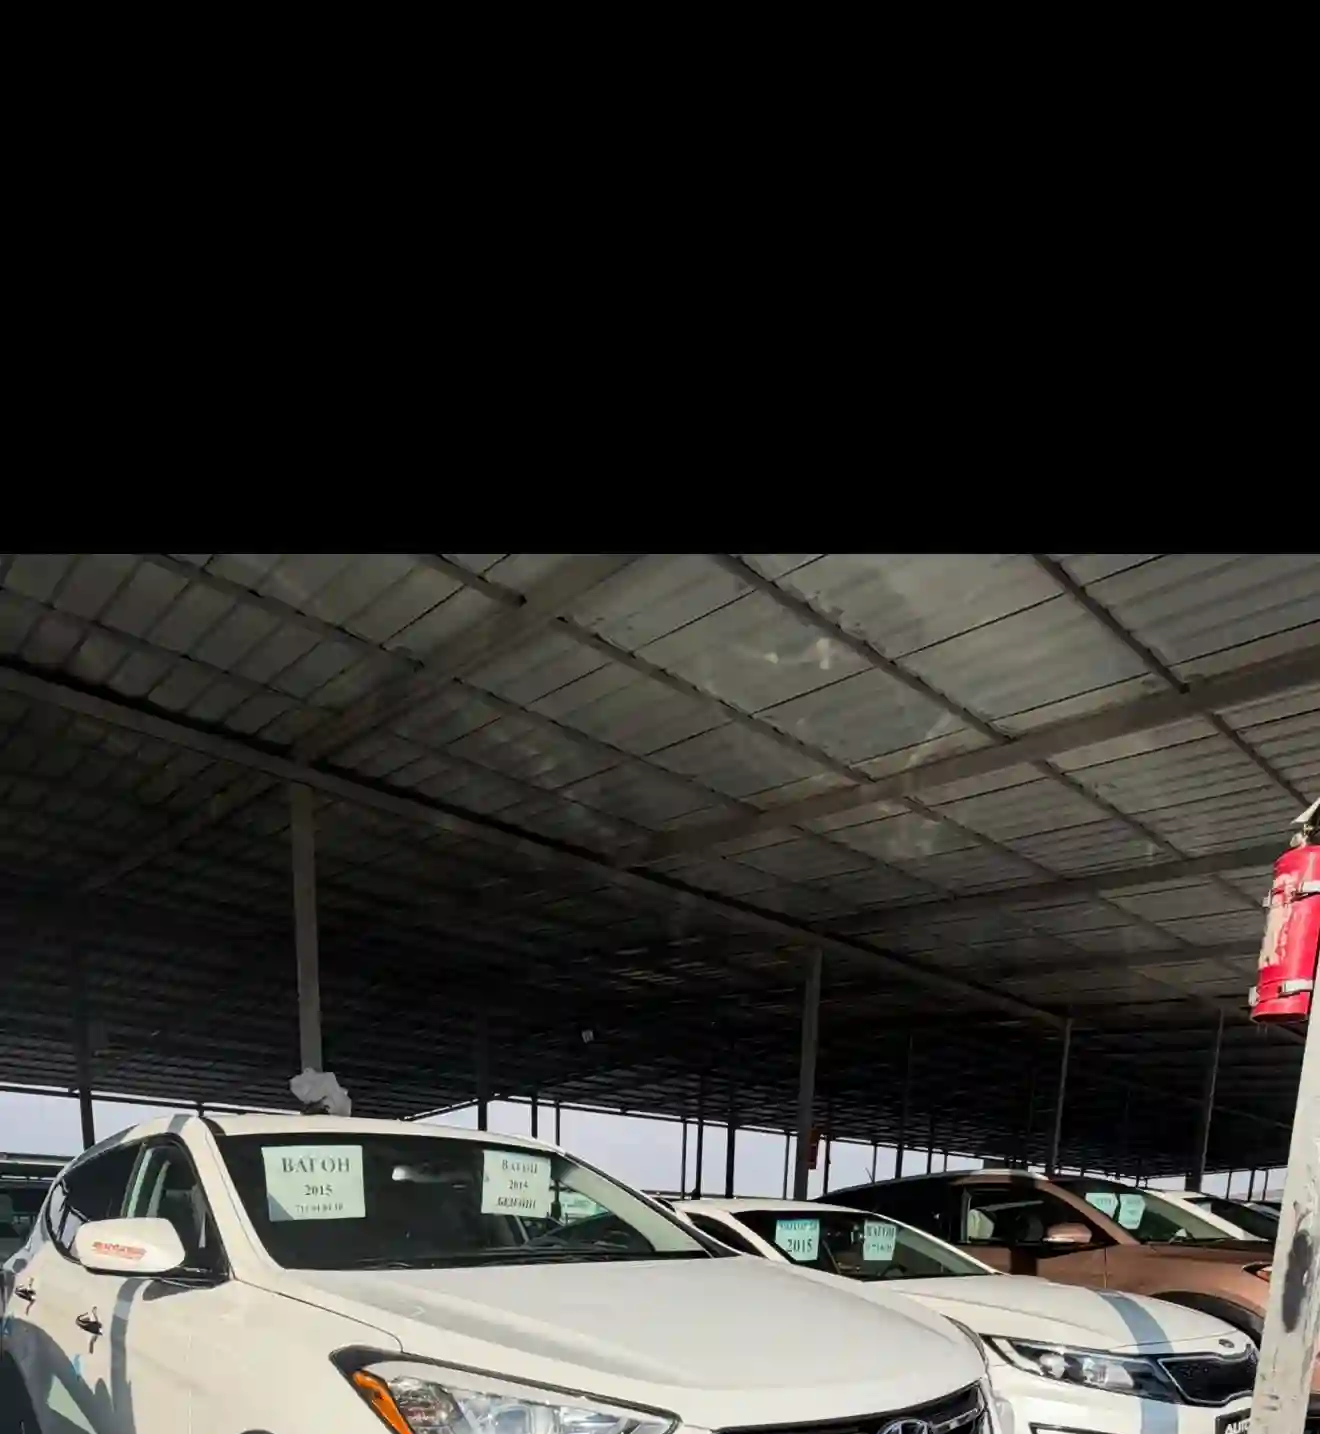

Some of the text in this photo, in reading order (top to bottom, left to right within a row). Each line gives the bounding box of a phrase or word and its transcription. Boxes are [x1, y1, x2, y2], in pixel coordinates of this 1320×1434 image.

[281, 1157, 350, 1173] ВАГОН
[303, 1184, 333, 1197] 2015
[787, 1237, 813, 1253] 2015
